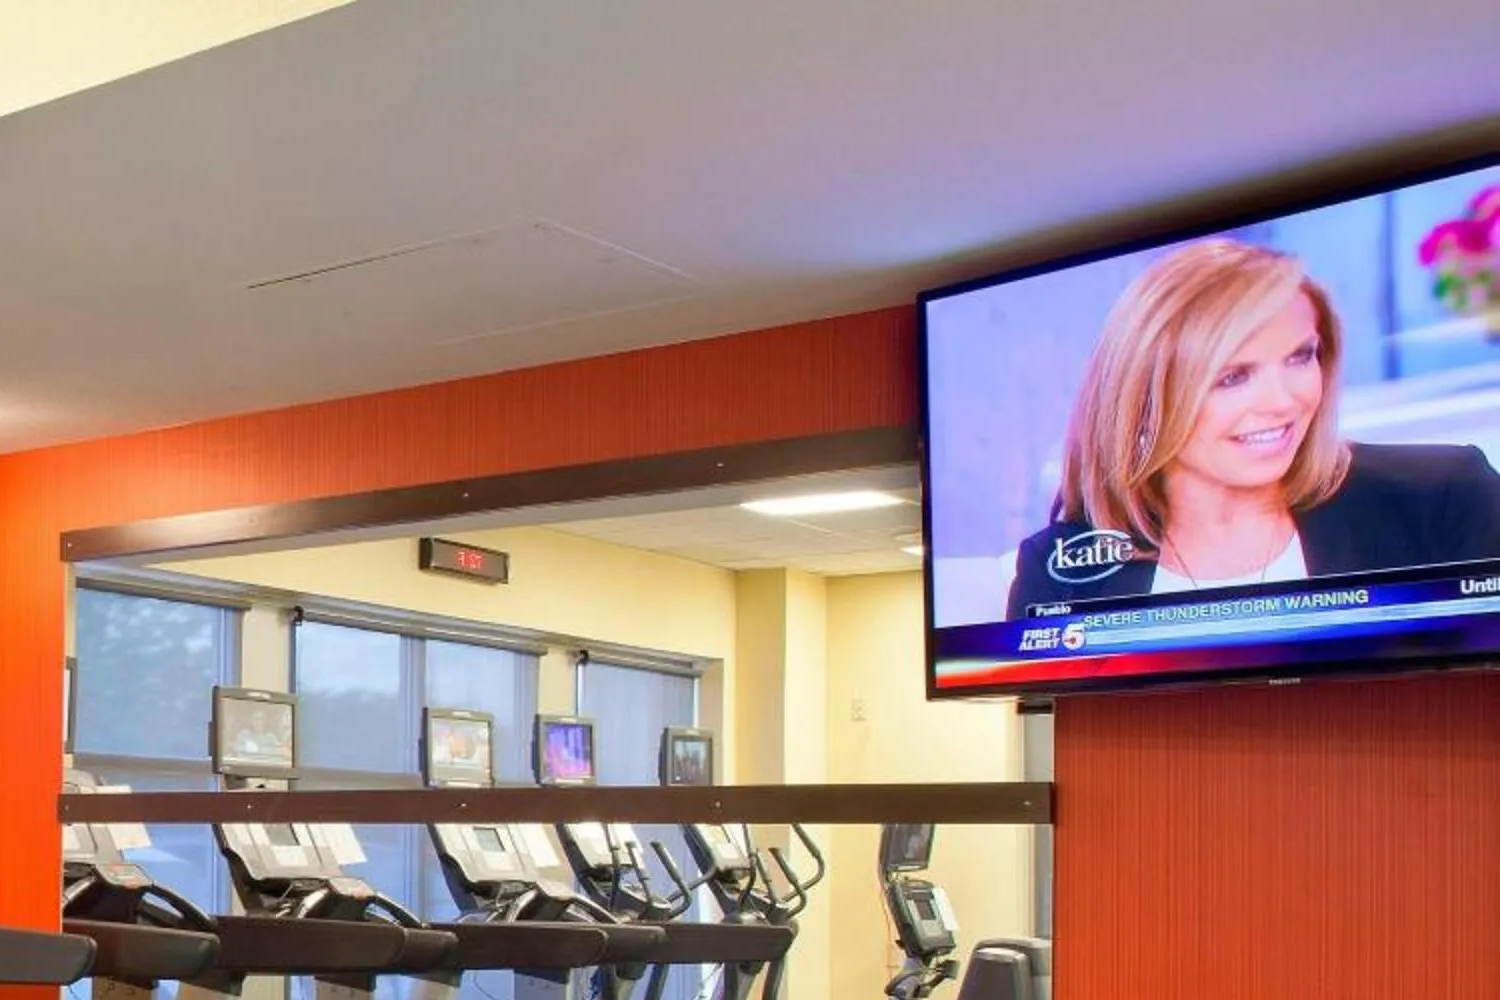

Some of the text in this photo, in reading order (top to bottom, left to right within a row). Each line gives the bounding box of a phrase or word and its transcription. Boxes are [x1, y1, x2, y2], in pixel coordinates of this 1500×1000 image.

[1055, 536, 1132, 568] katie
[1084, 589, 1369, 628] SEVERE THUNDERSTORM WARNING
[1018, 638, 1060, 651] ALERT
[1023, 624, 1085, 650] FIRST 5
